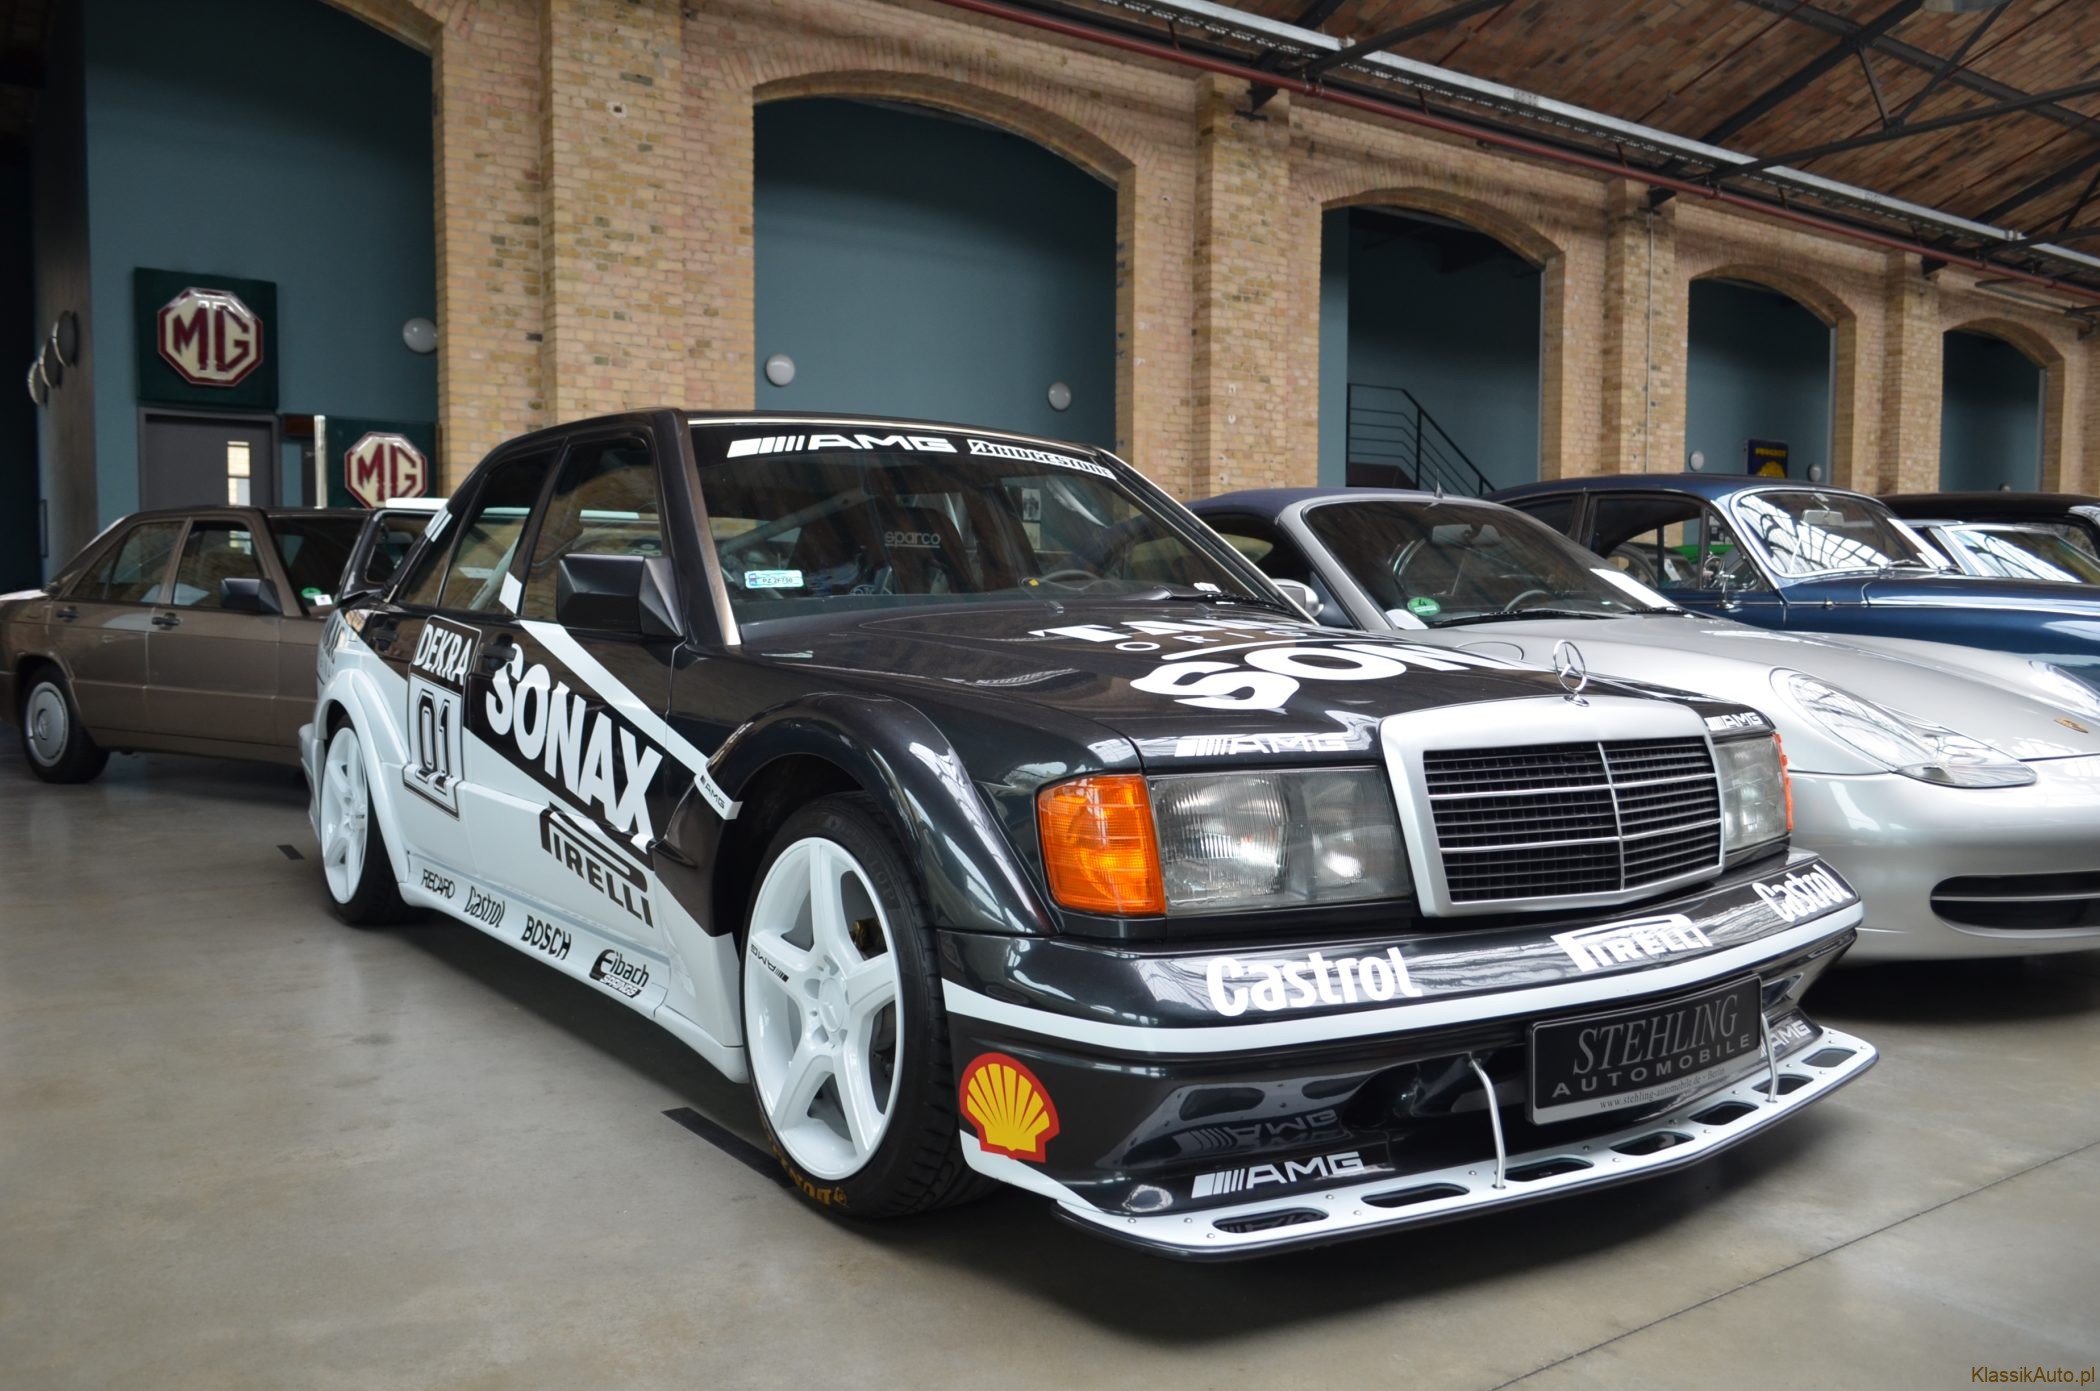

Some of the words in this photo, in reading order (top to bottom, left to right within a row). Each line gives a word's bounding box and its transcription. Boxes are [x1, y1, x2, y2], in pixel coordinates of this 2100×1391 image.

[172, 301, 251, 372] MG
[807, 434, 958, 454] AMG
[967, 438, 1117, 481] BRIDGESTONE
[356, 441, 417, 502] MG
[884, 530, 941, 546] sparco
[412, 624, 473, 686] DEKRA
[416, 688, 455, 796] 01
[1721, 712, 1764, 729] AMG
[485, 643, 664, 855] SONAX
[1229, 733, 1349, 754] AMG
[704, 783, 726, 809] AMG
[421, 868, 456, 899] RECARO
[540, 801, 655, 929] PIRELLI
[463, 885, 506, 928] Castrol
[1752, 864, 1854, 922] Castrol
[521, 915, 572, 960] BOSCH
[750, 944, 777, 972] AMG
[1551, 913, 1713, 973] PIRELLI
[589, 948, 650, 988] Eibach
[1207, 946, 1423, 1016] Castrol
[1573, 994, 1739, 1075] STEHLING
[1768, 1019, 1812, 1051] AMG
[1552, 1034, 1750, 1098] AUTOMOBILE
[1246, 1151, 1365, 1190] AMG
